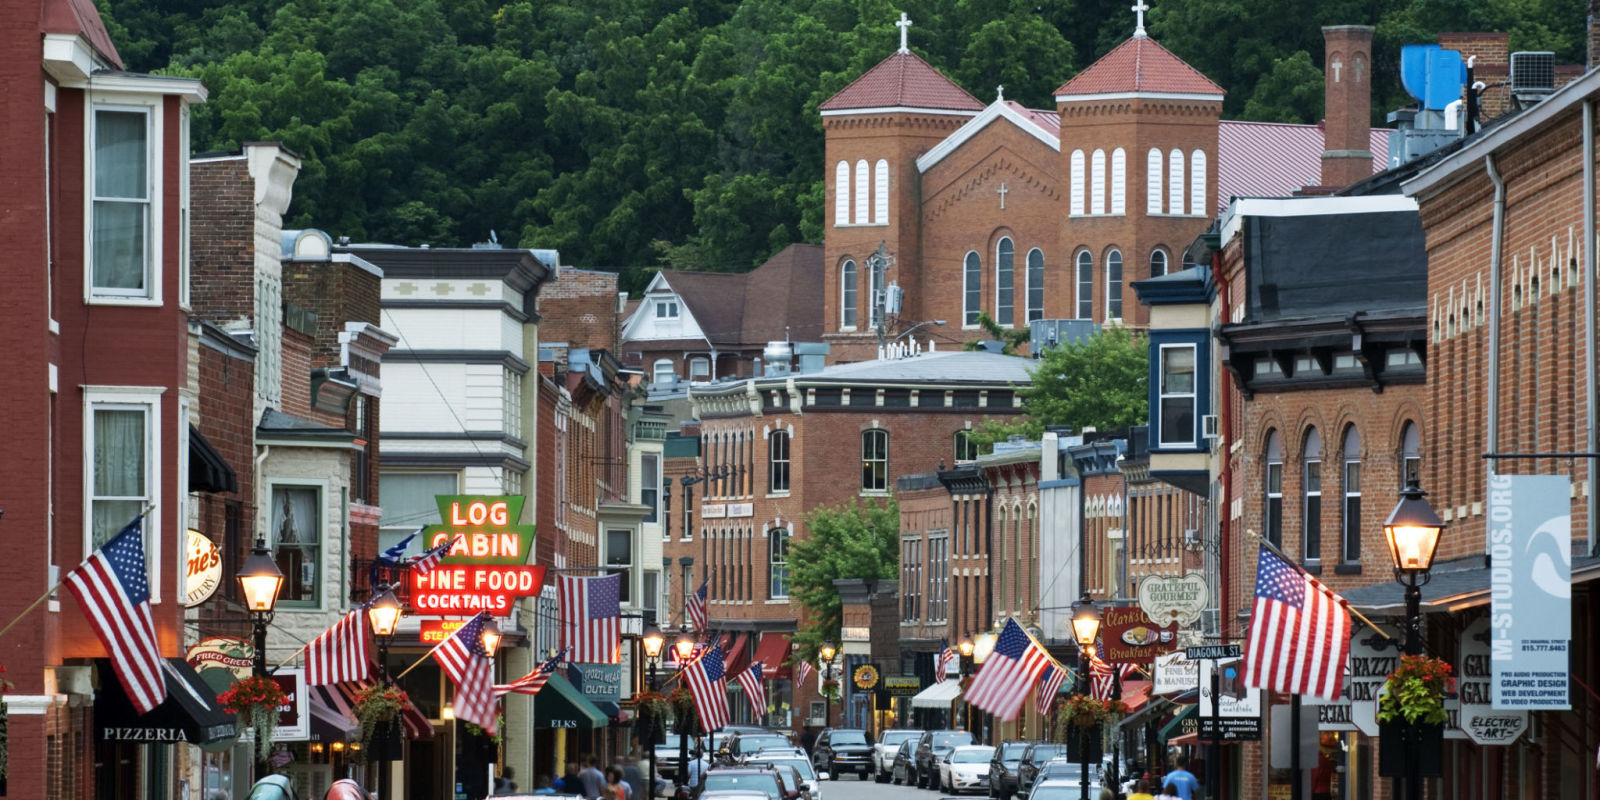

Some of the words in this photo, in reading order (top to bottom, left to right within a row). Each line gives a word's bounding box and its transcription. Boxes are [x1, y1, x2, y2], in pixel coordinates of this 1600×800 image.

[452, 502, 508, 525] LOG
[433, 532, 519, 557] CABIN
[1491, 474, 1512, 661] M-STUDIOS.ORG
[417, 570, 466, 590] FINE
[475, 570, 533, 591] FOOD
[1147, 582, 1201, 593] GRATEFUL
[417, 594, 506, 609] COCKTAILS
[1150, 591, 1199, 601] GOURMET
[1106, 610, 1140, 627] Clark's
[1110, 646, 1153, 660] Breakfast
[1188, 647, 1227, 659] DIAGONAL
[1229, 645, 1240, 656] ST.
[196, 652, 223, 663] FRIED
[223, 657, 254, 667] GREEN
[1165, 667, 1183, 676] FINE
[585, 685, 619, 694] OUTLET
[551, 719, 577, 728] ELKS
[1471, 718, 1521, 728] ELECTRIC
[103, 727, 188, 742] PIZZERIA
